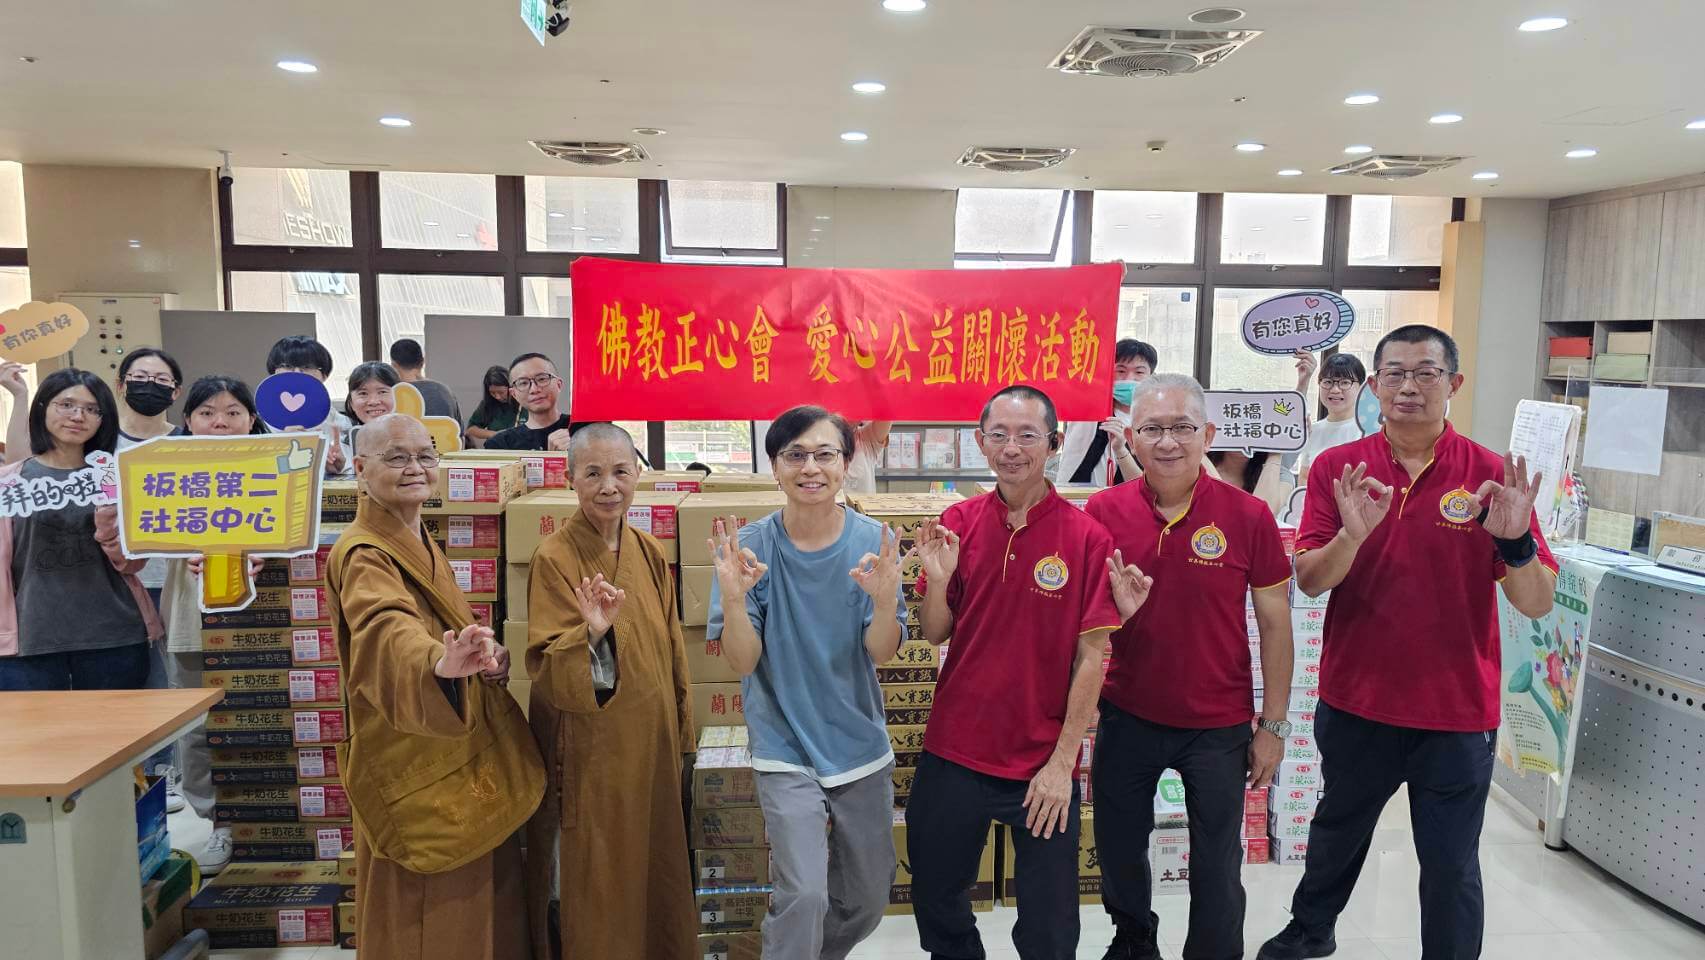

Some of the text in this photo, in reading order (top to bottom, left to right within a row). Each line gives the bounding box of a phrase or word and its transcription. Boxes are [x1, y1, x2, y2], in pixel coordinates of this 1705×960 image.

[1, 313, 73, 351] 有你真好
[1252, 311, 1333, 340] 有您真好
[597, 301, 1100, 386] 佛教正心會 愛心公益關懷活動
[1222, 403, 1262, 420] 板橋
[143, 471, 278, 499] 板橋第二
[139, 506, 276, 534] 社福中心
[232, 633, 282, 644] 牛奶花生
[231, 674, 280, 685] 牛奶花生
[889, 669, 932, 682] 八寶粥
[890, 689, 933, 704] 八寶粥
[235, 713, 284, 723] 牛奶花生
[260, 827, 306, 837] 牛奶花生
[709, 868, 717, 878] 2
[1160, 868, 1189, 882] 土豆
[221, 886, 321, 898] 牛奶花生
[709, 912, 717, 923] 3
